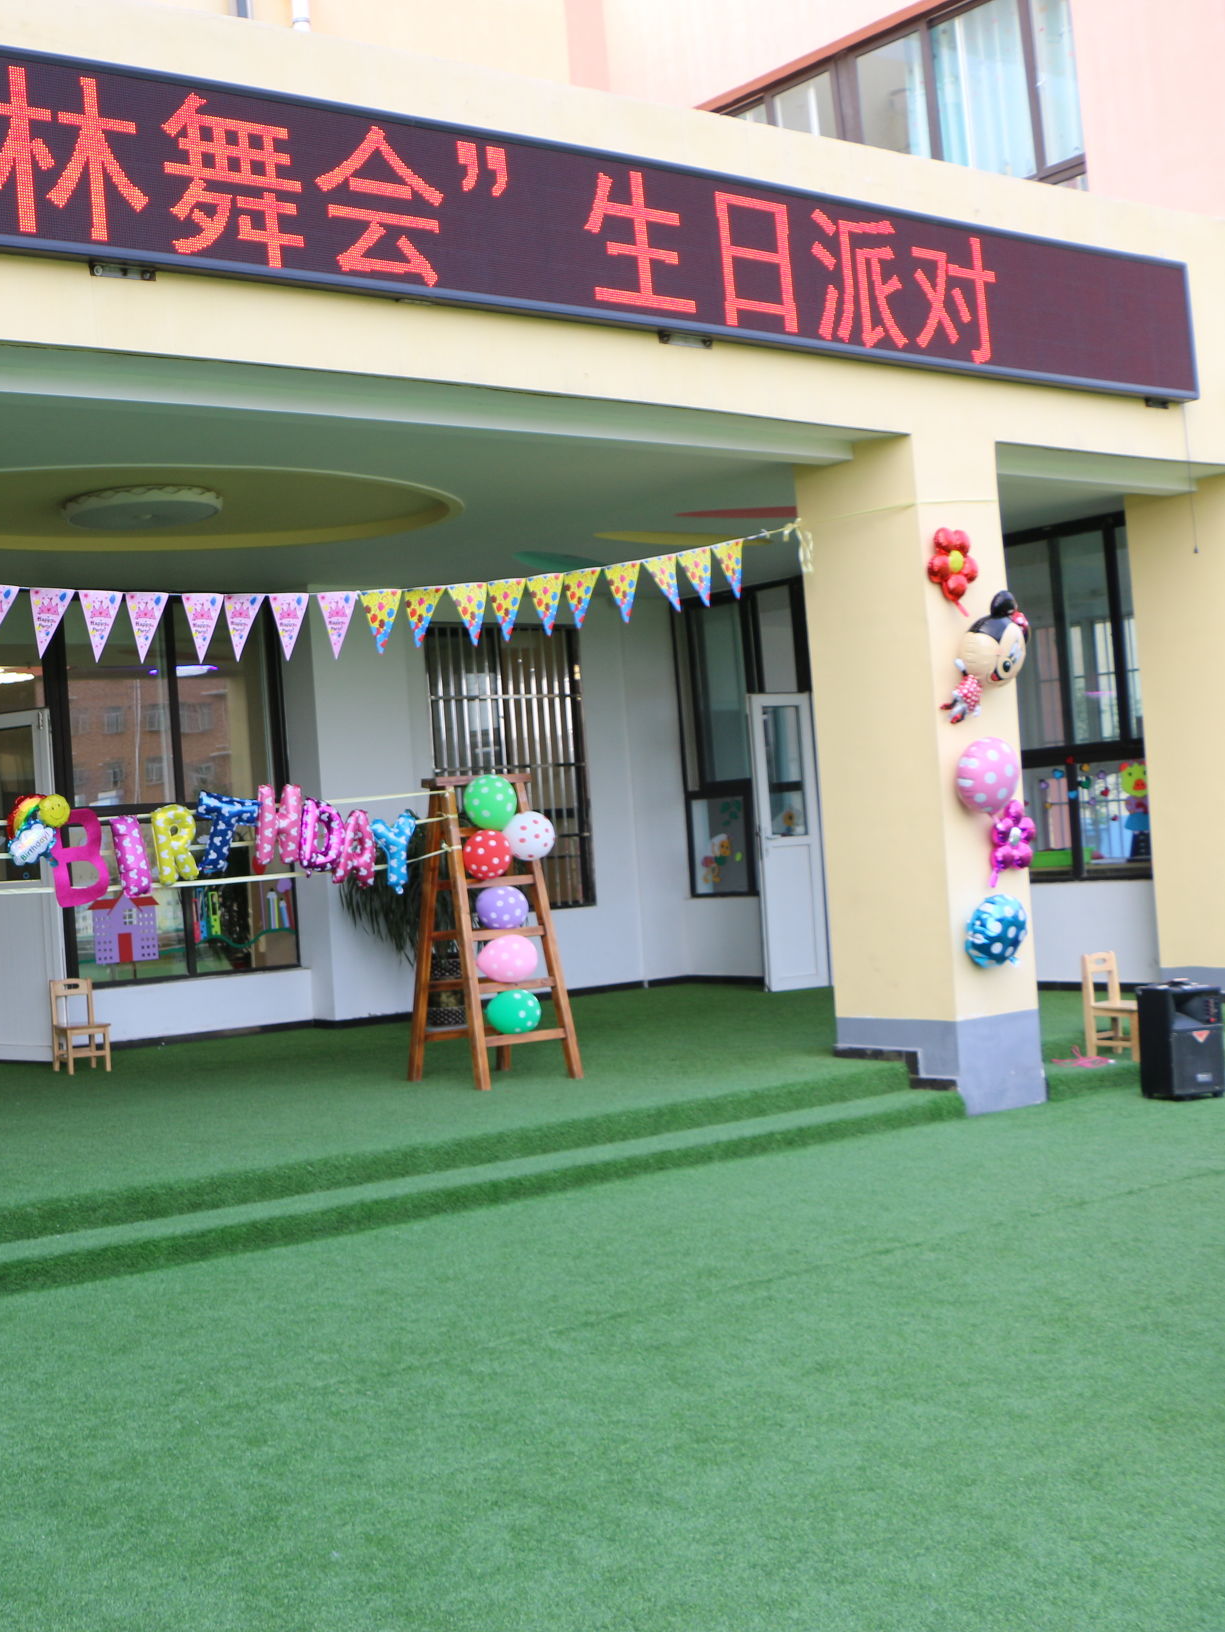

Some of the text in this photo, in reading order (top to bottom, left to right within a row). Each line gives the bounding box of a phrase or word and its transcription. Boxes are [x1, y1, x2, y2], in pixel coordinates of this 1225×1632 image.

[583, 170, 995, 364] 生日派对
[51, 783, 416, 908] BIRTHDAY
